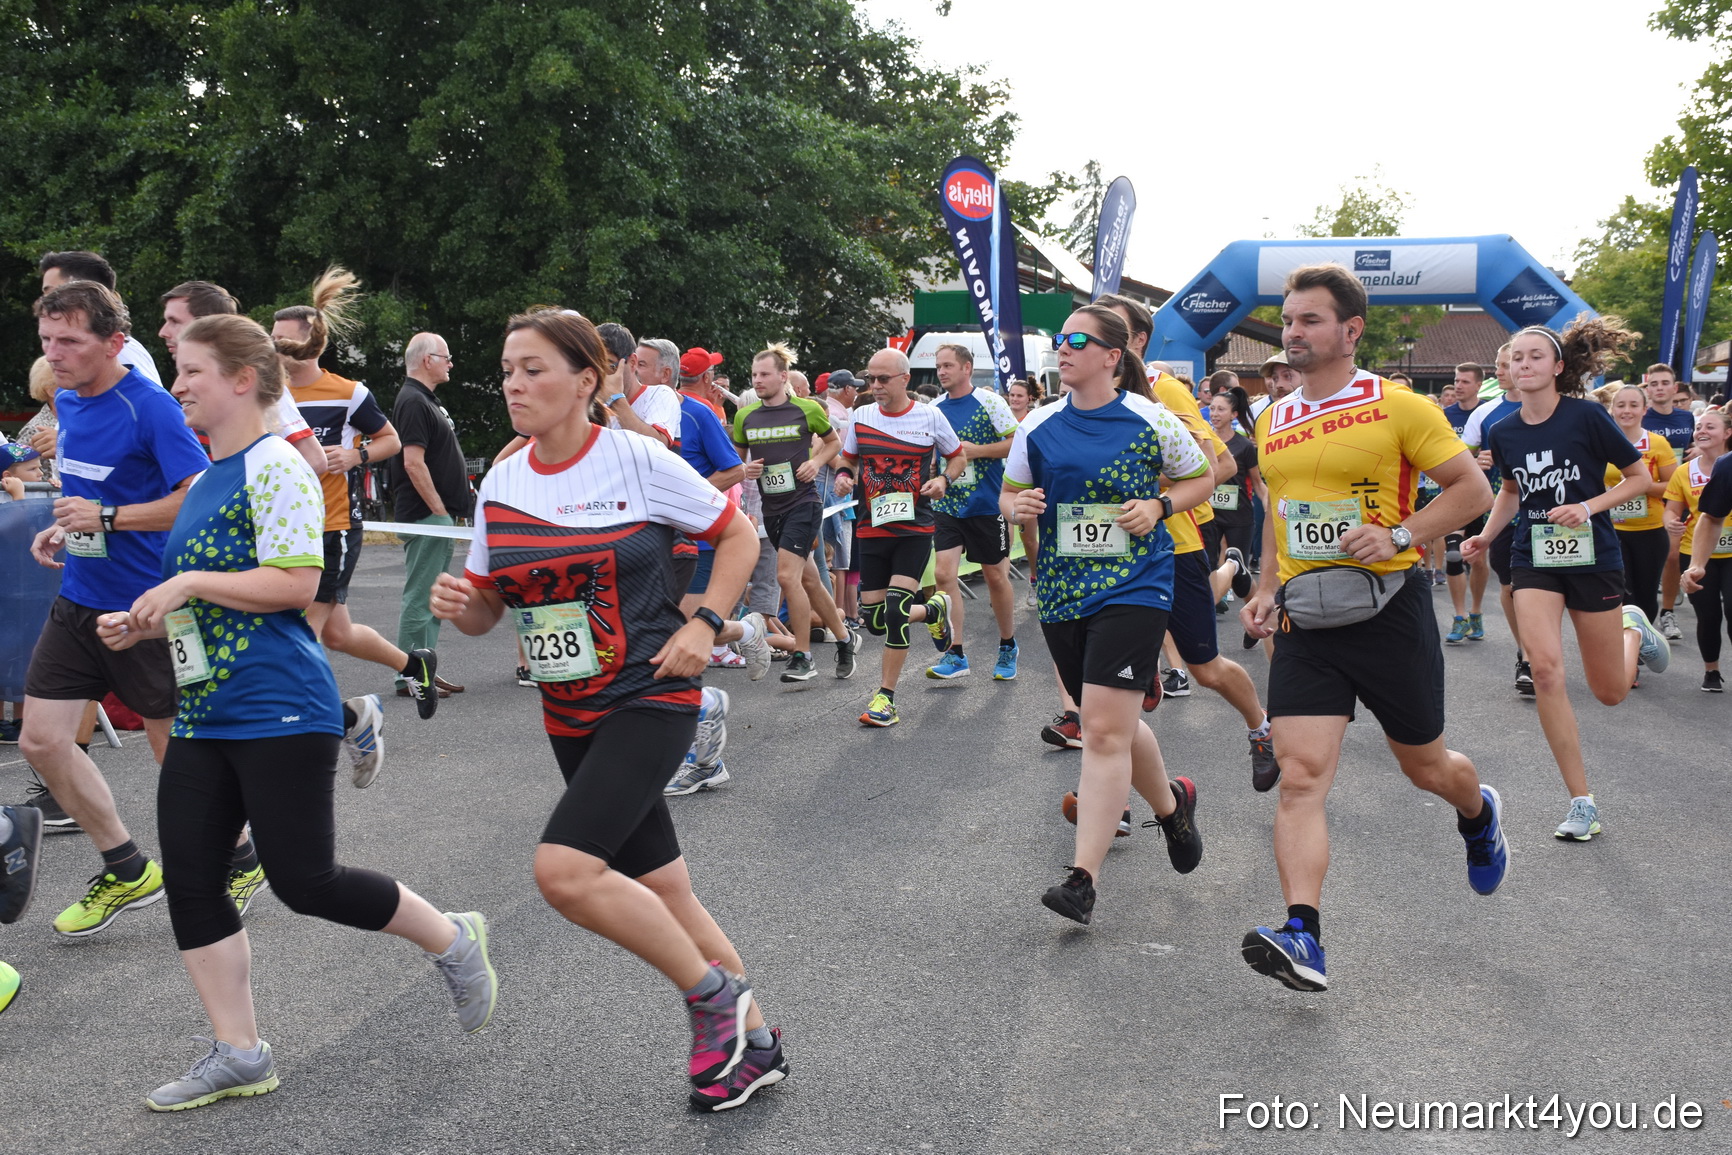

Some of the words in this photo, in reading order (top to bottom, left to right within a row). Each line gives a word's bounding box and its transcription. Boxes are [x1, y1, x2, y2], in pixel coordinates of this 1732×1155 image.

[1358, 271, 1422, 286] menlauf
[1189, 298, 1231, 309] Fischer
[746, 425, 801, 441] BOCK
[1265, 427, 1315, 455] MAX
[1322, 408, 1388, 434] BÖGL
[765, 474, 786, 486] 303
[1512, 459, 1580, 505] Burgis
[1212, 492, 1230, 502] 169
[556, 501, 615, 515] NEUMARKT
[876, 502, 908, 518] 2272
[1528, 509, 1549, 519] Knöd
[1072, 524, 1112, 542] 197
[1544, 539, 1580, 555] 392
[524, 631, 580, 660] 2238
